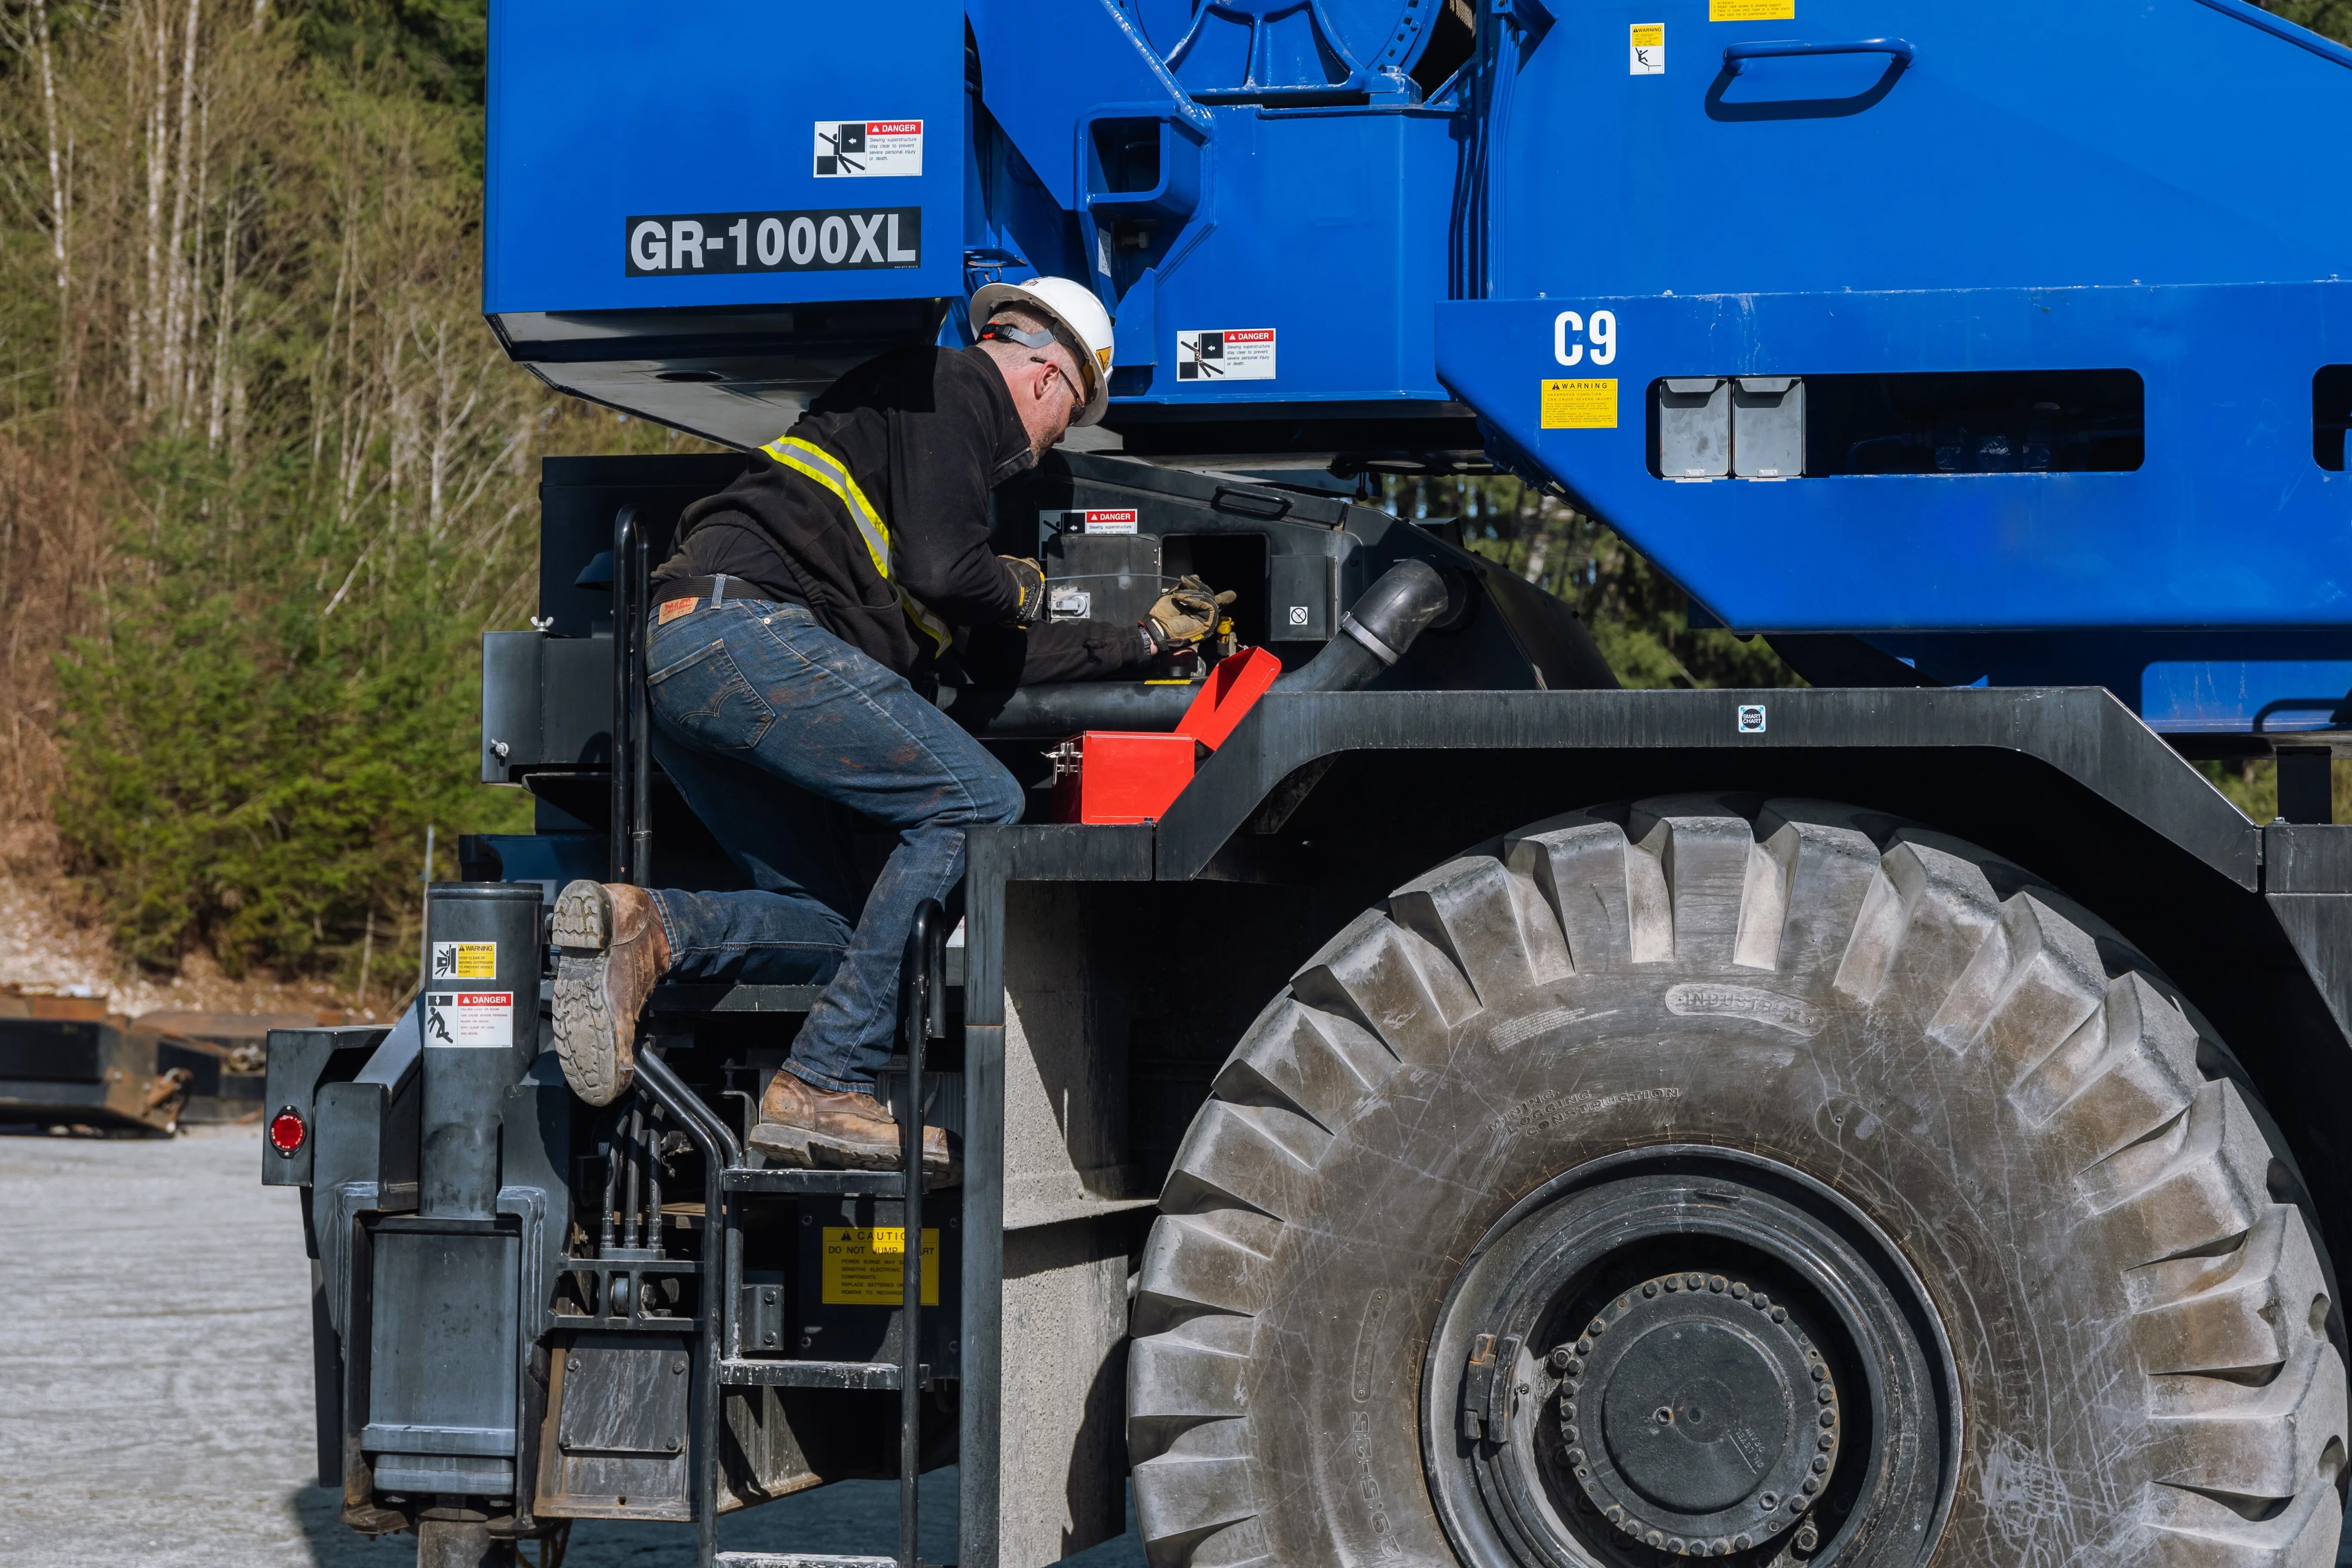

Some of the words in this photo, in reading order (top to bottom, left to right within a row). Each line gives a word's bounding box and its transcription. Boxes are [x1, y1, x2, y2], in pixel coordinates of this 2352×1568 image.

[631, 214, 916, 270] GR-1000XL
[1555, 310, 1616, 366] C9
[1505, 1090, 1591, 1136] LOGGING
[1525, 1088, 1679, 1137] CONSTRUCTION
[847, 1246, 865, 1254] NOT
[1363, 1300, 1382, 1345] NYLON
[1754, 1453, 1764, 1468] OIL
[1351, 1412, 1401, 1558] 29.5-25
